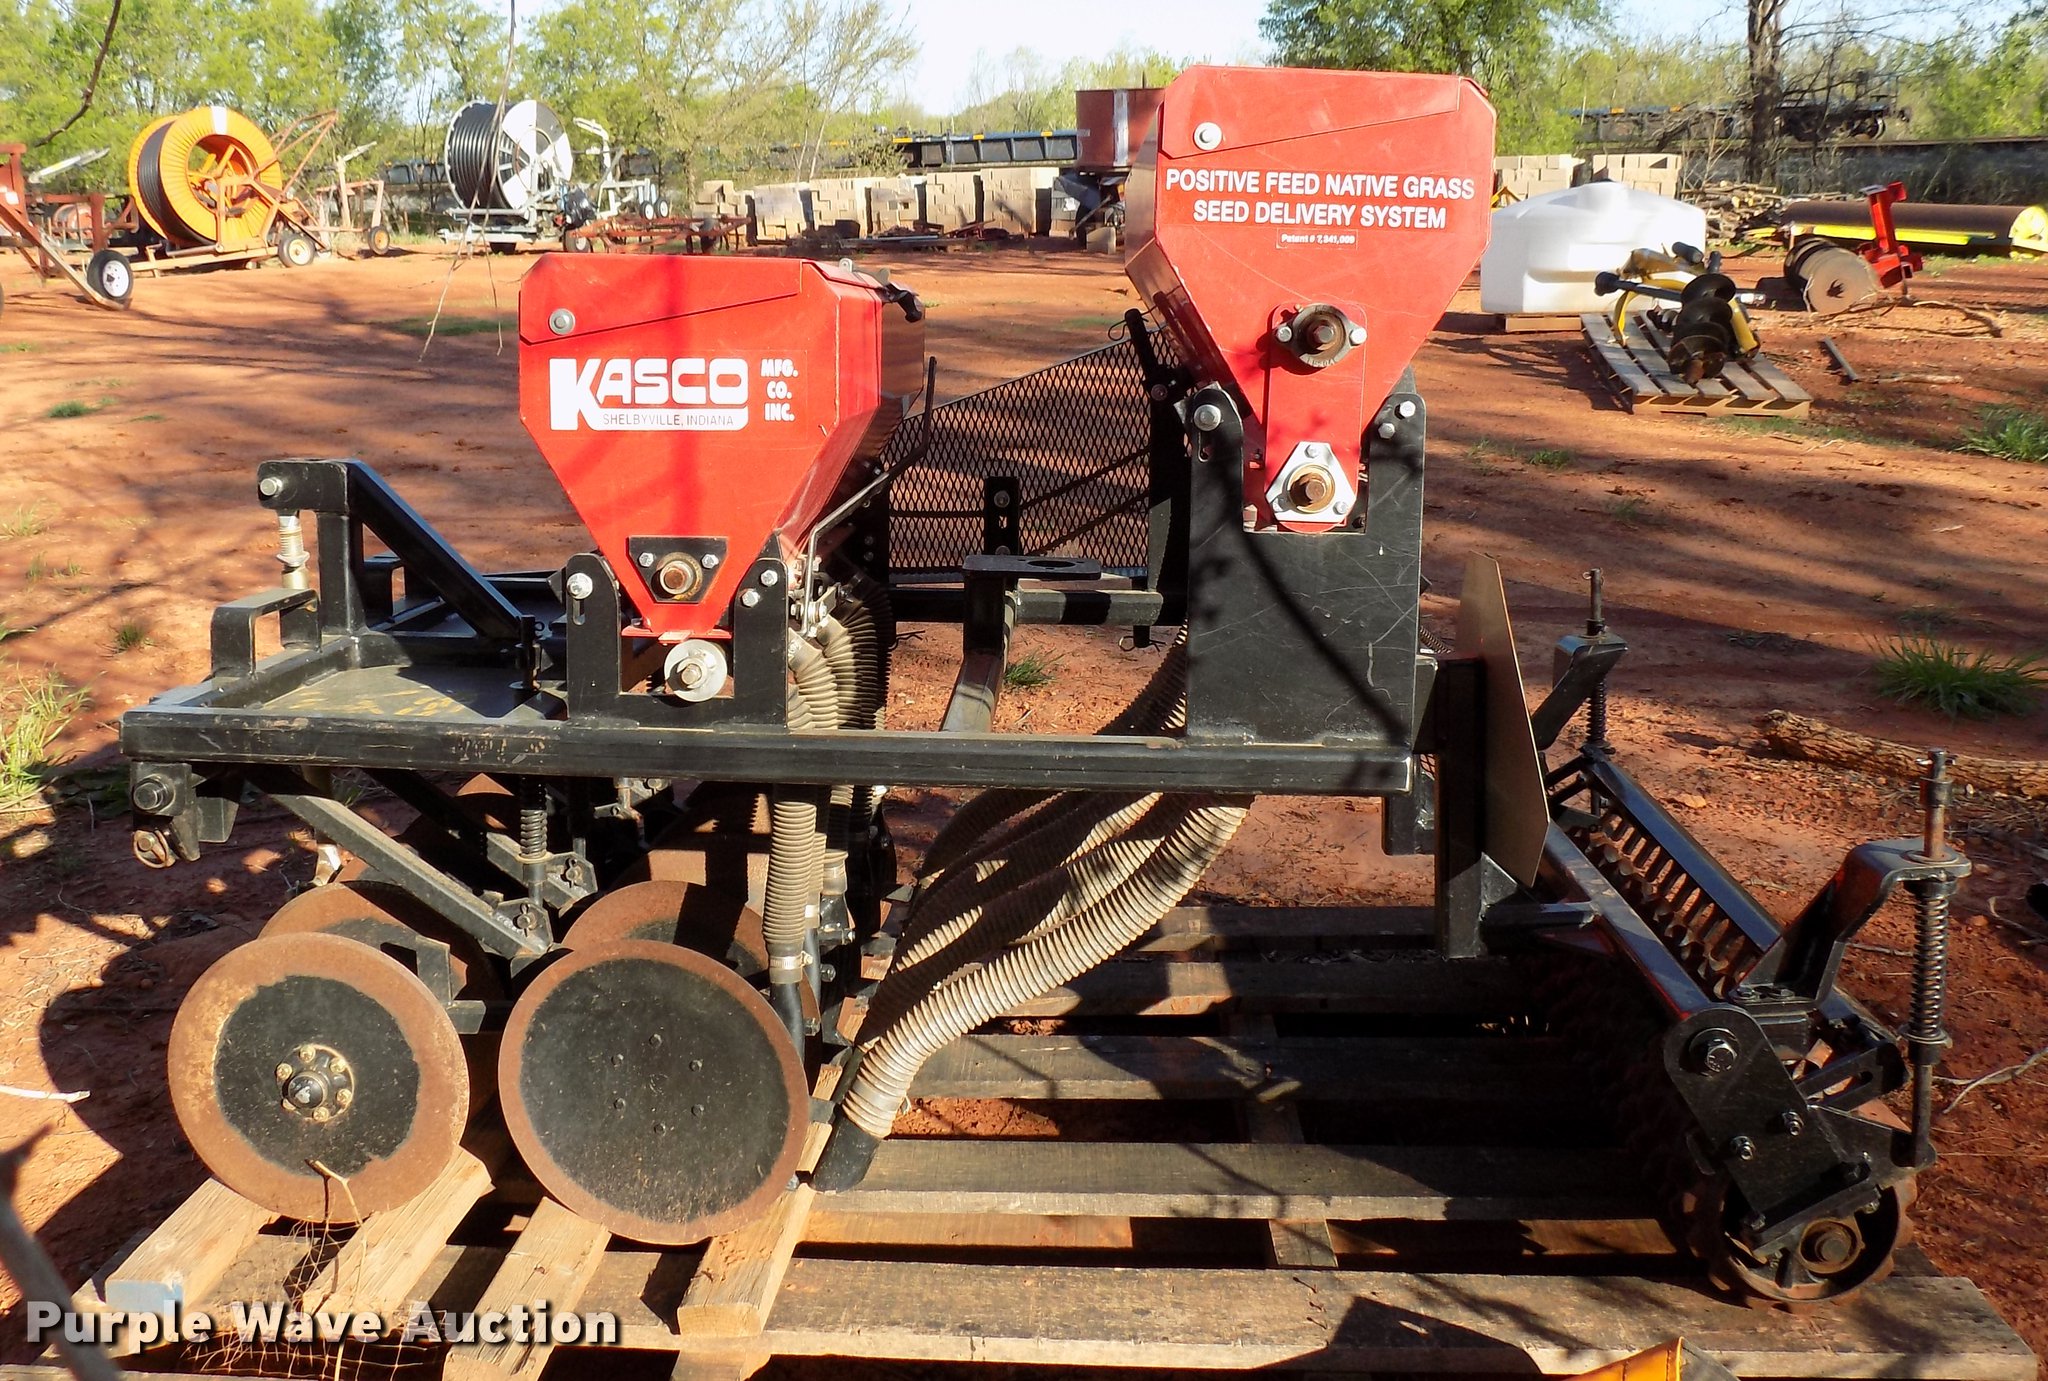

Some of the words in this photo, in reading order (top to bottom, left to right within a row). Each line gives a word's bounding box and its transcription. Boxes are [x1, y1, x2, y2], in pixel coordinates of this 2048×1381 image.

[1165, 169, 1260, 193] POSITIVE
[1265, 172, 1320, 195] FEED
[1325, 174, 1398, 197] NATIVE
[1403, 176, 1475, 200] GRASS
[1193, 200, 1249, 223] SEED
[1254, 203, 1356, 226] DELIVERY
[1360, 206, 1446, 229] SYSTEM
[1281, 233, 1309, 243] Patent
[760, 358, 799, 378] MFG.
[549, 358, 749, 431] KASCO
[766, 380, 793, 400] CO.
[602, 414, 684, 428] SHELBYVILLE,
[686, 413, 734, 427] INDIANA
[763, 402, 796, 422] INC.
